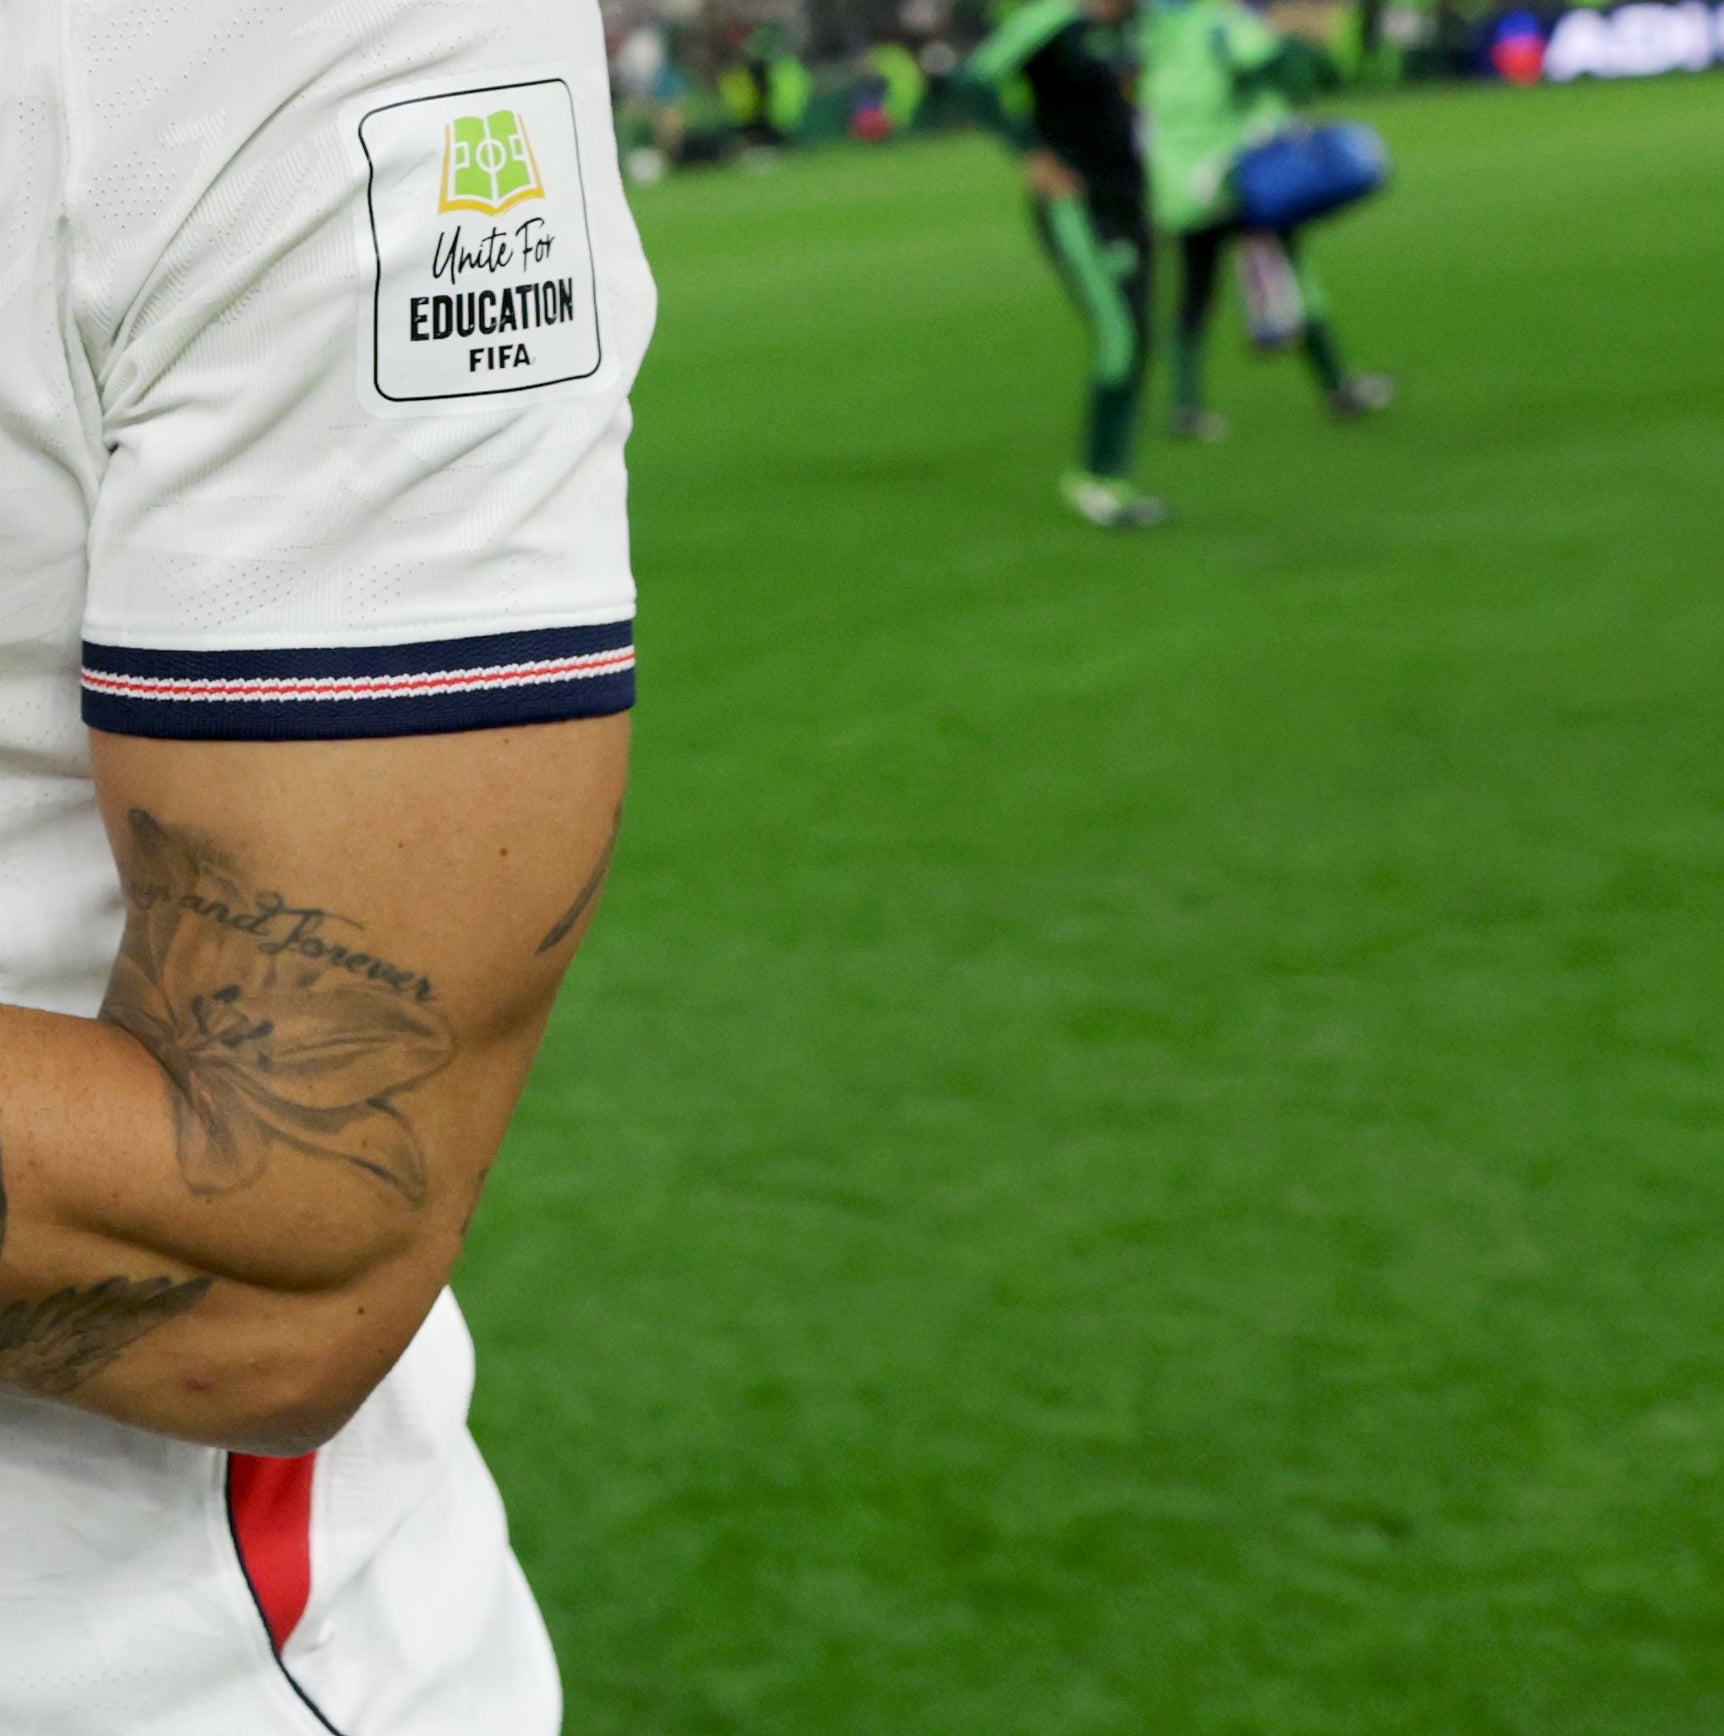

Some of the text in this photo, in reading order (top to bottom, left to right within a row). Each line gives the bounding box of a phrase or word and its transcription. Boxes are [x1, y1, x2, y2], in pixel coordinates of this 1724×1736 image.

[432, 217, 555, 285] Unite For
[410, 278, 574, 341] EDUCATION
[469, 343, 532, 372] FIFA
